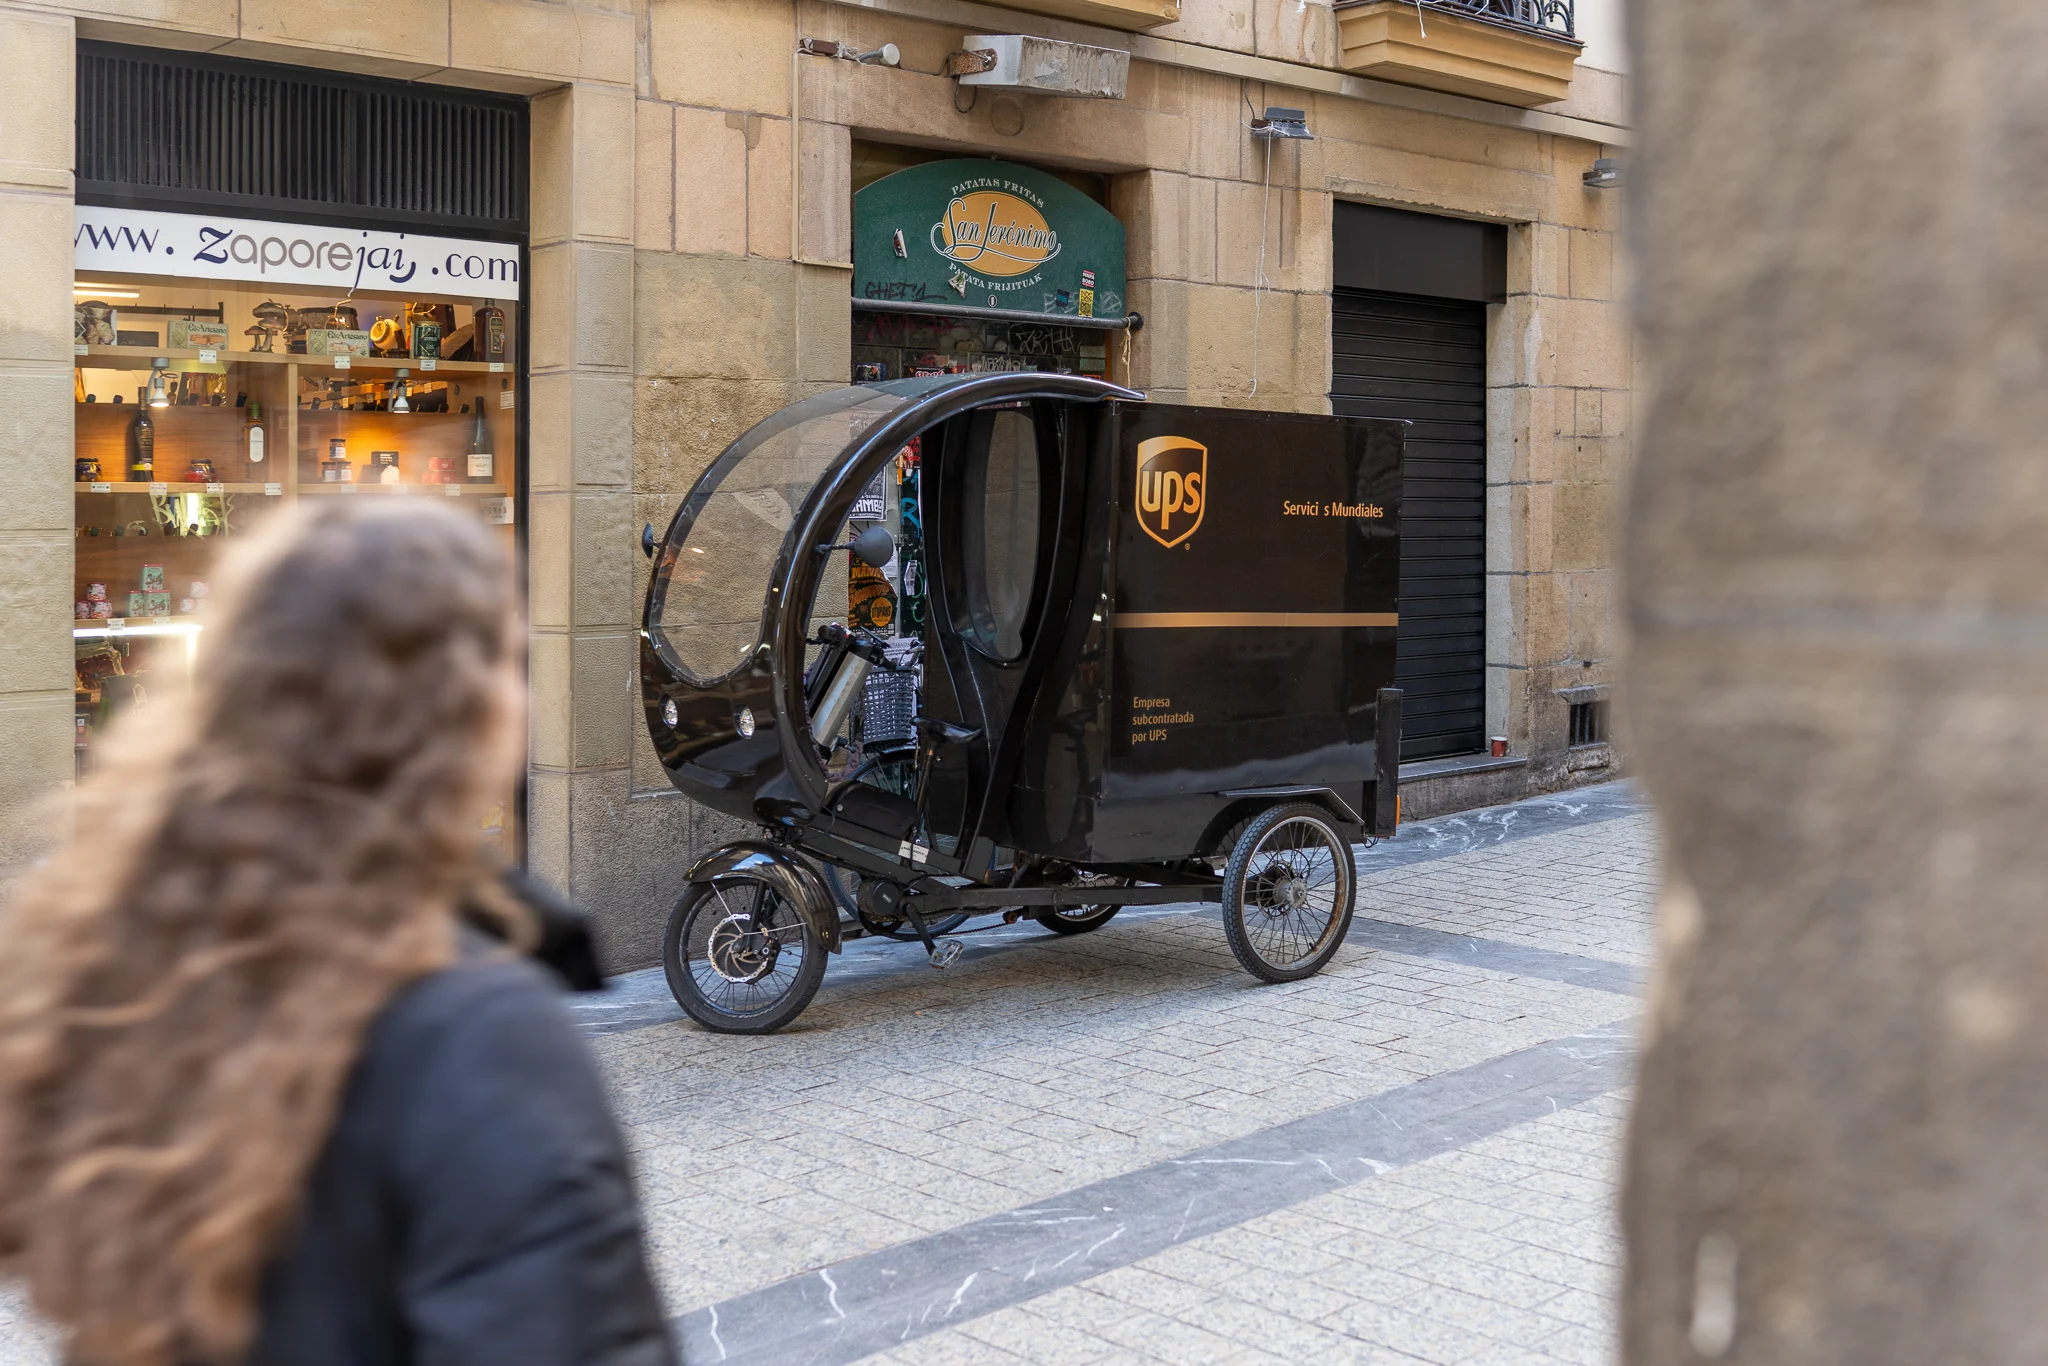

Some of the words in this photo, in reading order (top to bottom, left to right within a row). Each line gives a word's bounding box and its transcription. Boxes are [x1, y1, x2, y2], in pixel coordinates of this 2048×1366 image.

[951, 178, 1000, 196] PATATAS
[1004, 181, 1044, 209] FRITAS
[931, 197, 982, 262] San
[962, 201, 1062, 262] Jerónimo
[987, 272, 1043, 291] FRIJITUAK
[1331, 501, 1384, 518] Mundiales
[1133, 697, 1170, 710] Empresa
[1132, 711, 1194, 724] subcontratada
[1132, 731, 1147, 745] por
[1149, 730, 1167, 741] UPS
